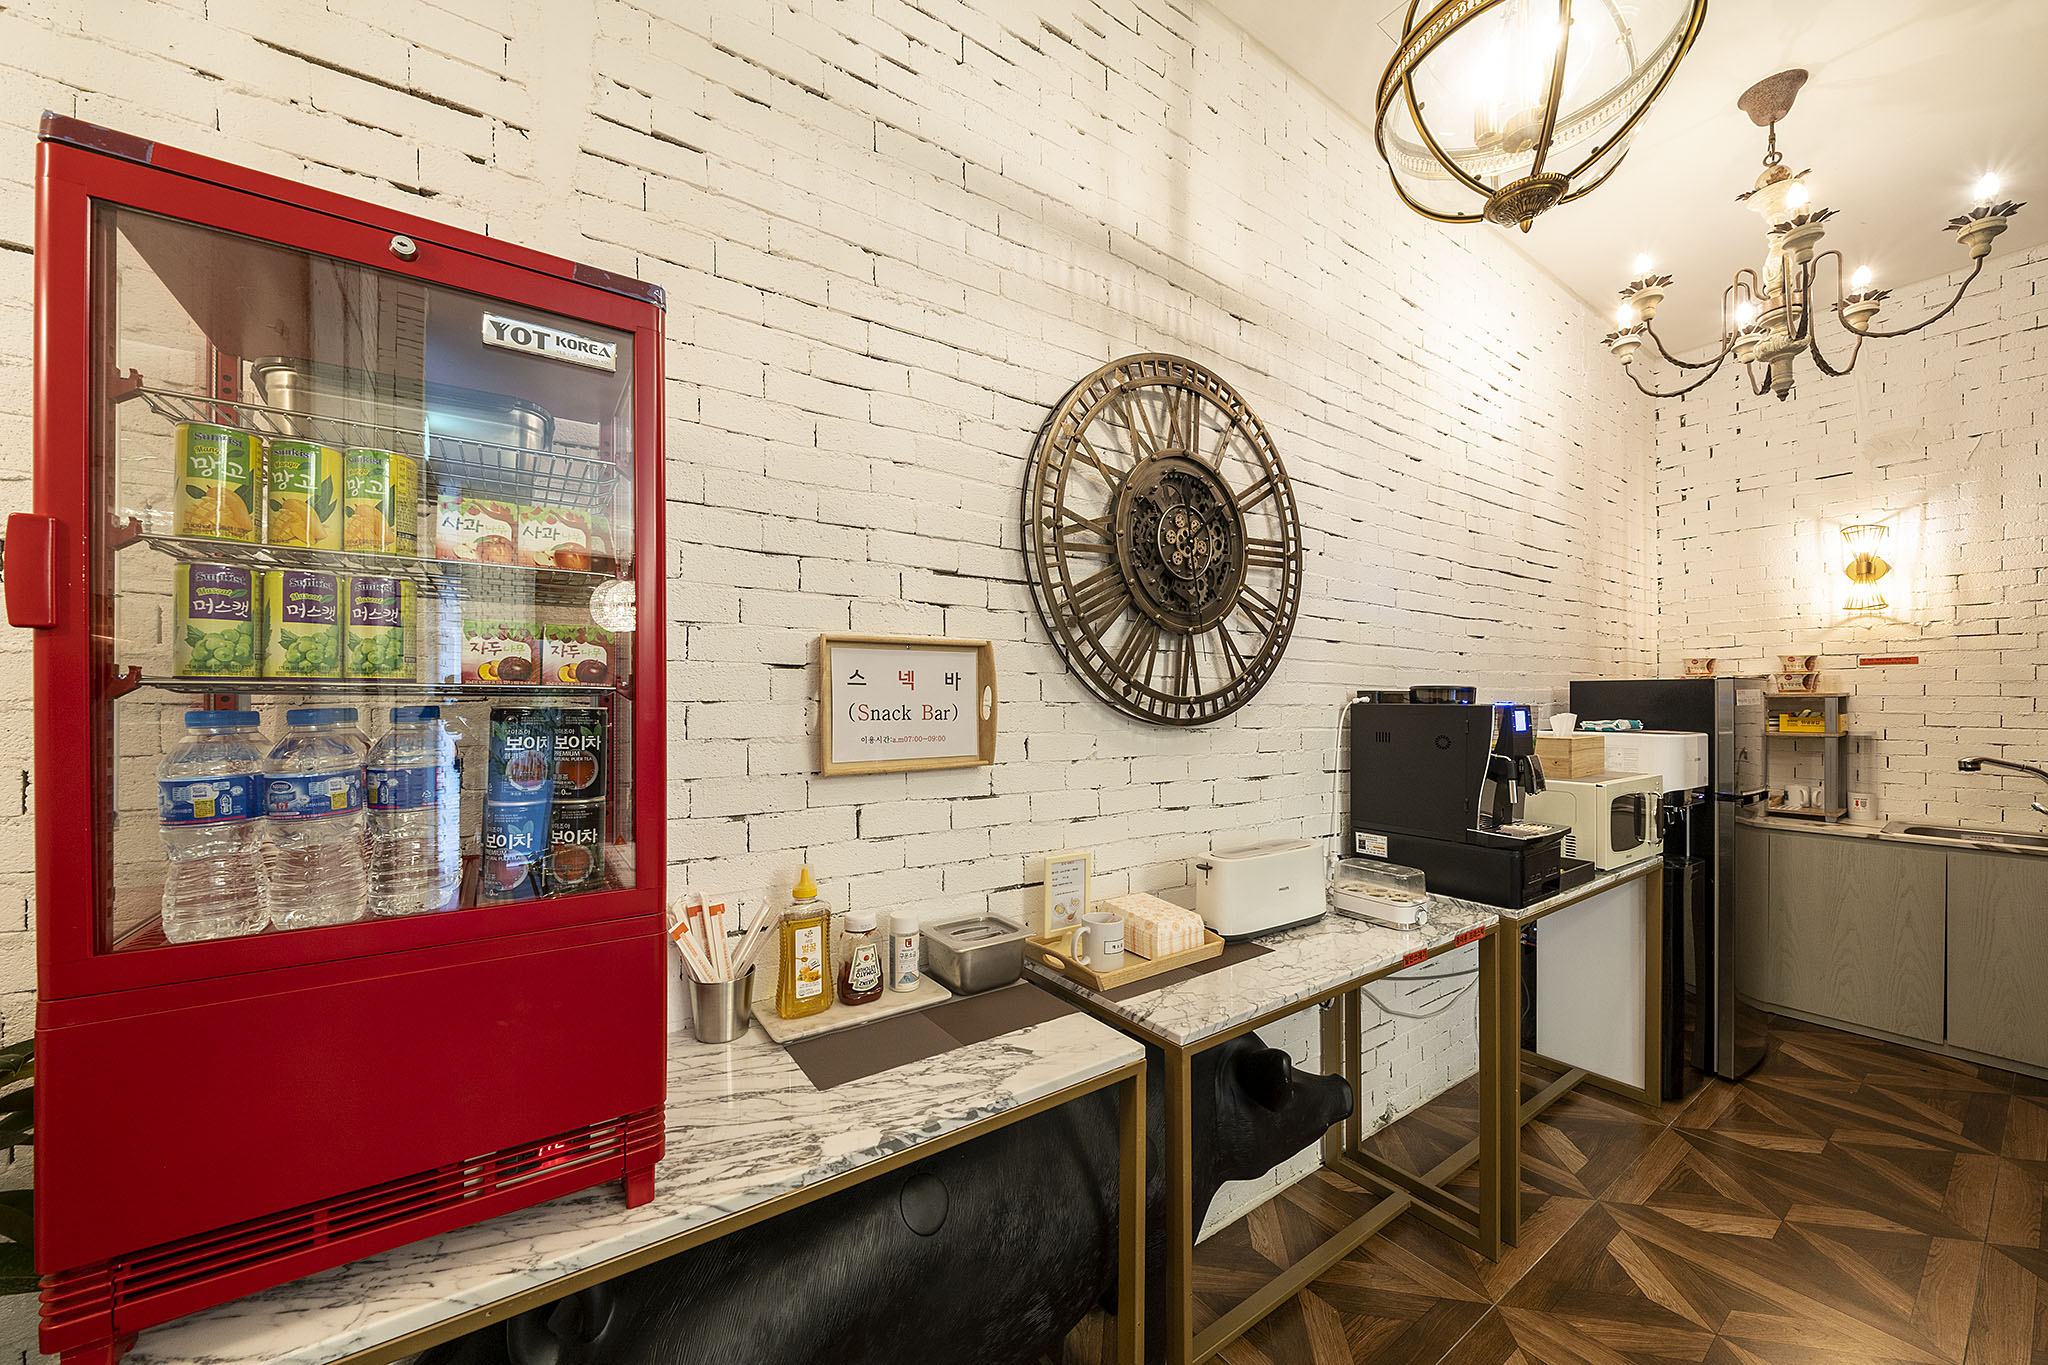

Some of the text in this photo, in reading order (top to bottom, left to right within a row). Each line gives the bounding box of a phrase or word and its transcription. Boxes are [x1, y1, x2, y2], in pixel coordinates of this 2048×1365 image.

[489, 320, 612, 358] YOT KOREA
[190, 454, 247, 477] 망고
[272, 469, 318, 490] 망고
[346, 476, 386, 497] 망고
[442, 516, 484, 533] 사과
[522, 525, 560, 541] 사과
[192, 597, 249, 618] 머스캣
[286, 602, 336, 622] 머스캣
[352, 606, 399, 624] 머스캣
[469, 641, 503, 656] 자두
[551, 644, 580, 659] 자두
[847, 669, 961, 692] 스 넥 바
[849, 703, 959, 722] (Snack Bar)
[554, 735, 602, 751] 보이차
[551, 828, 598, 845] 보이차
